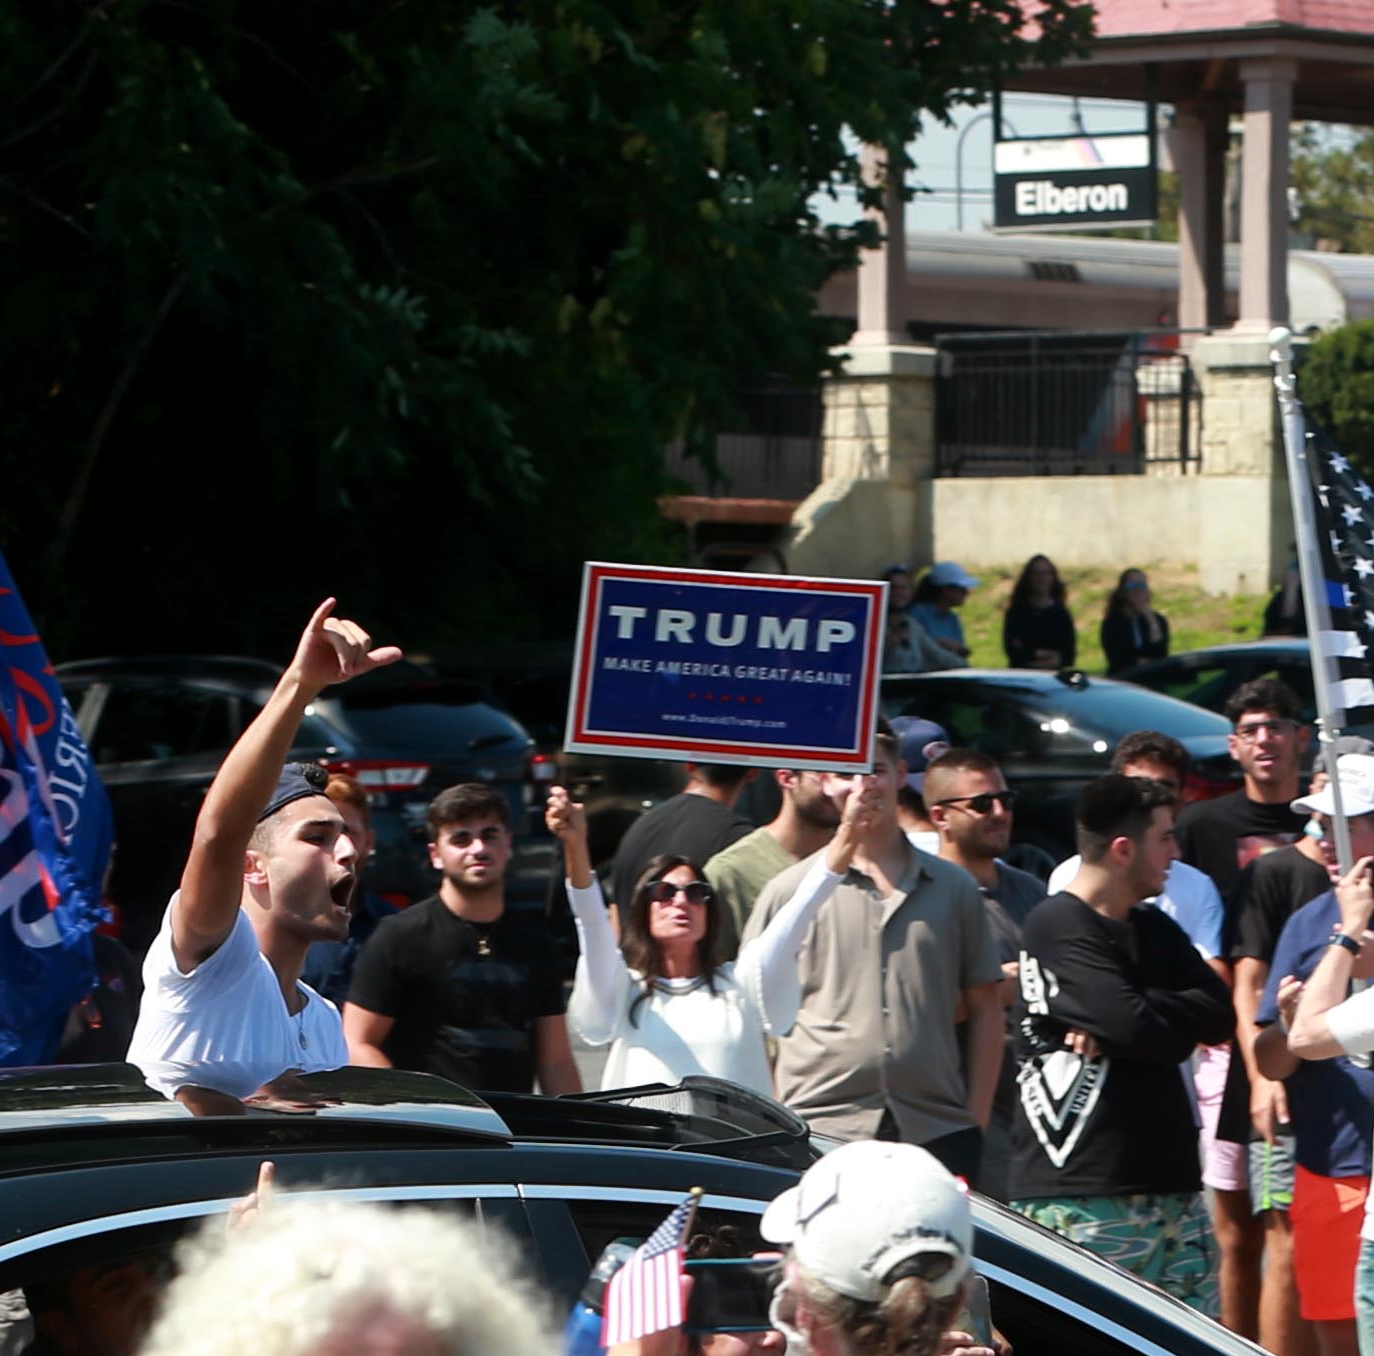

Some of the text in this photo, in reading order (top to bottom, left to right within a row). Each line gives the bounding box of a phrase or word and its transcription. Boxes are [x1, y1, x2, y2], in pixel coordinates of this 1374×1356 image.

[1015, 180, 1128, 215] Elberon
[608, 605, 857, 653] TRUMP
[603, 657, 852, 686] MAKE AMERICA GREAT AGAIN!
